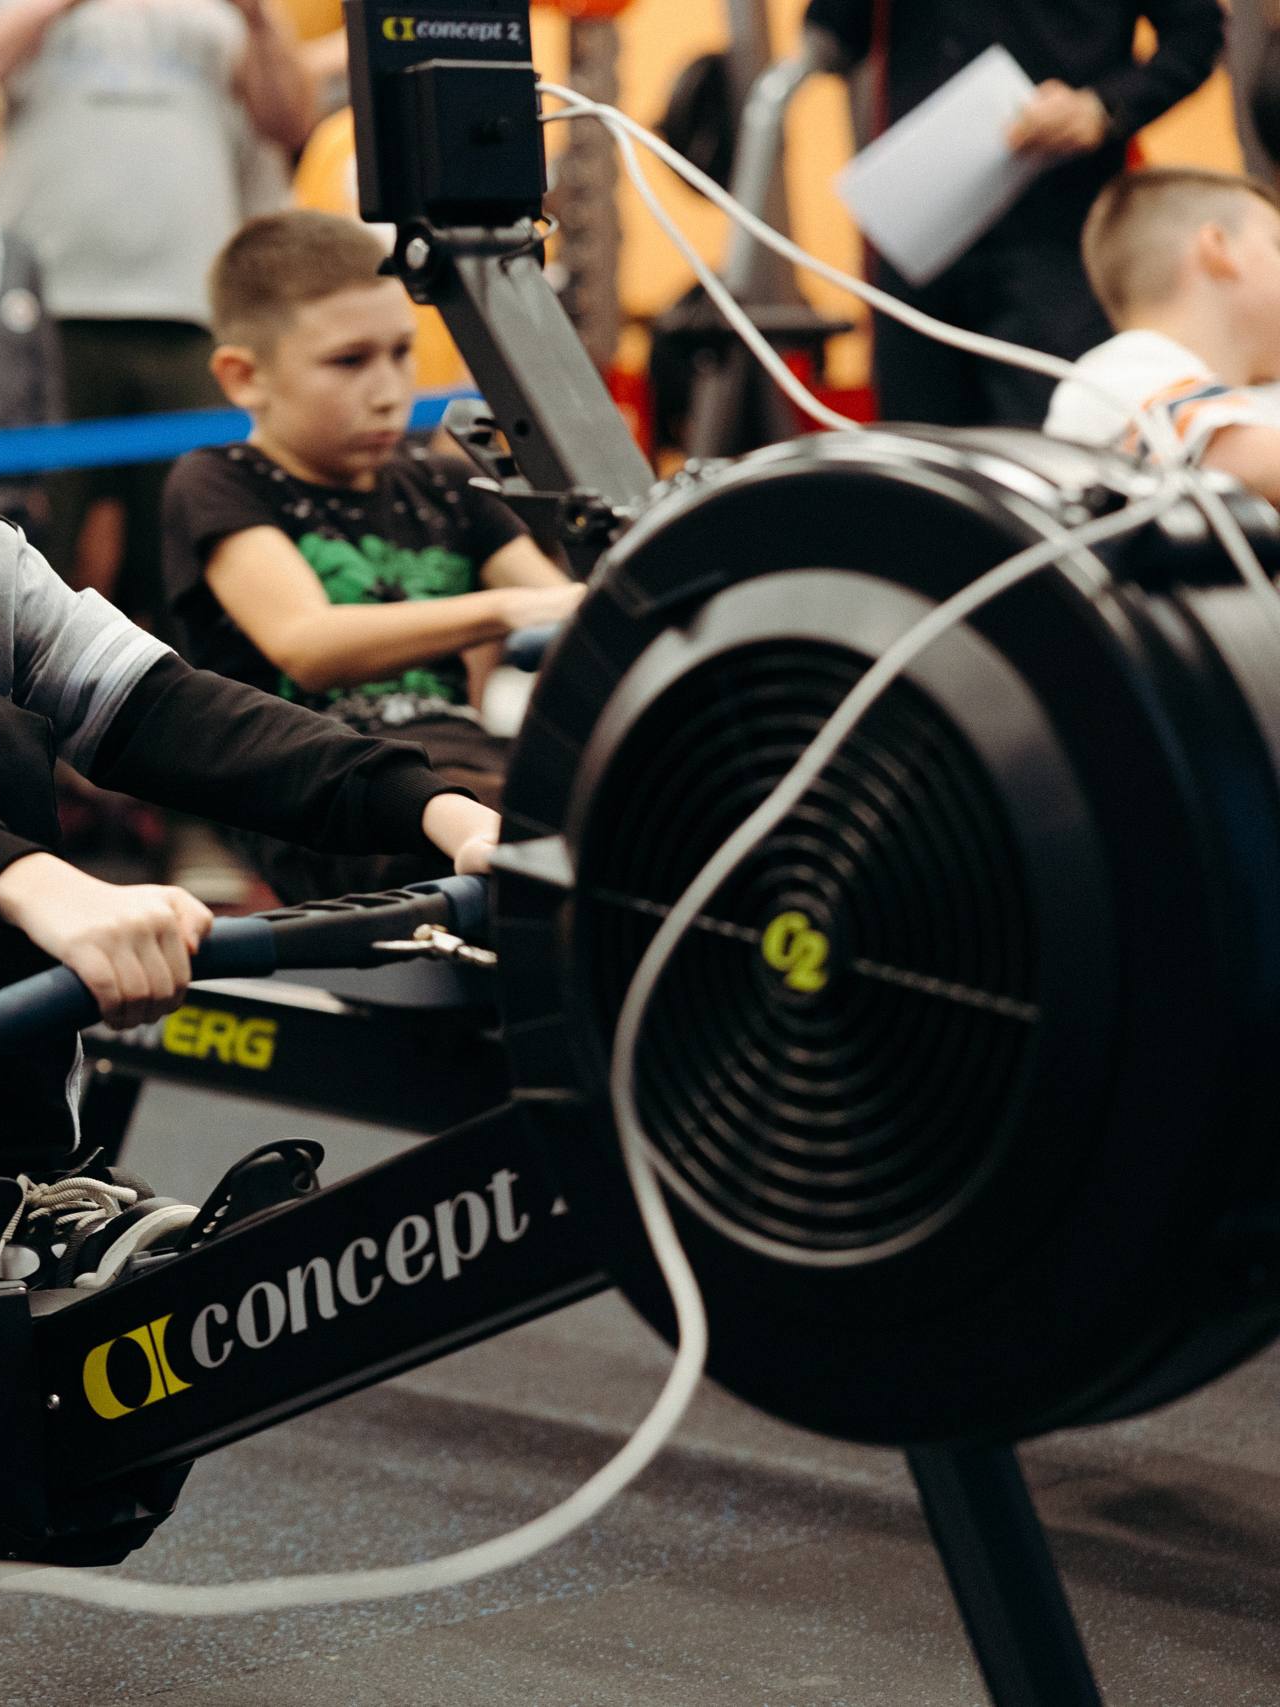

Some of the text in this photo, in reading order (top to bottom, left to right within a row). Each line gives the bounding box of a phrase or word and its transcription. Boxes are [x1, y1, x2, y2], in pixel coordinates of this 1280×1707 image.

[417, 20, 502, 41] concept
[507, 22, 520, 40] 2
[120, 1004, 279, 1071] ERG
[191, 1168, 529, 1368] concept
